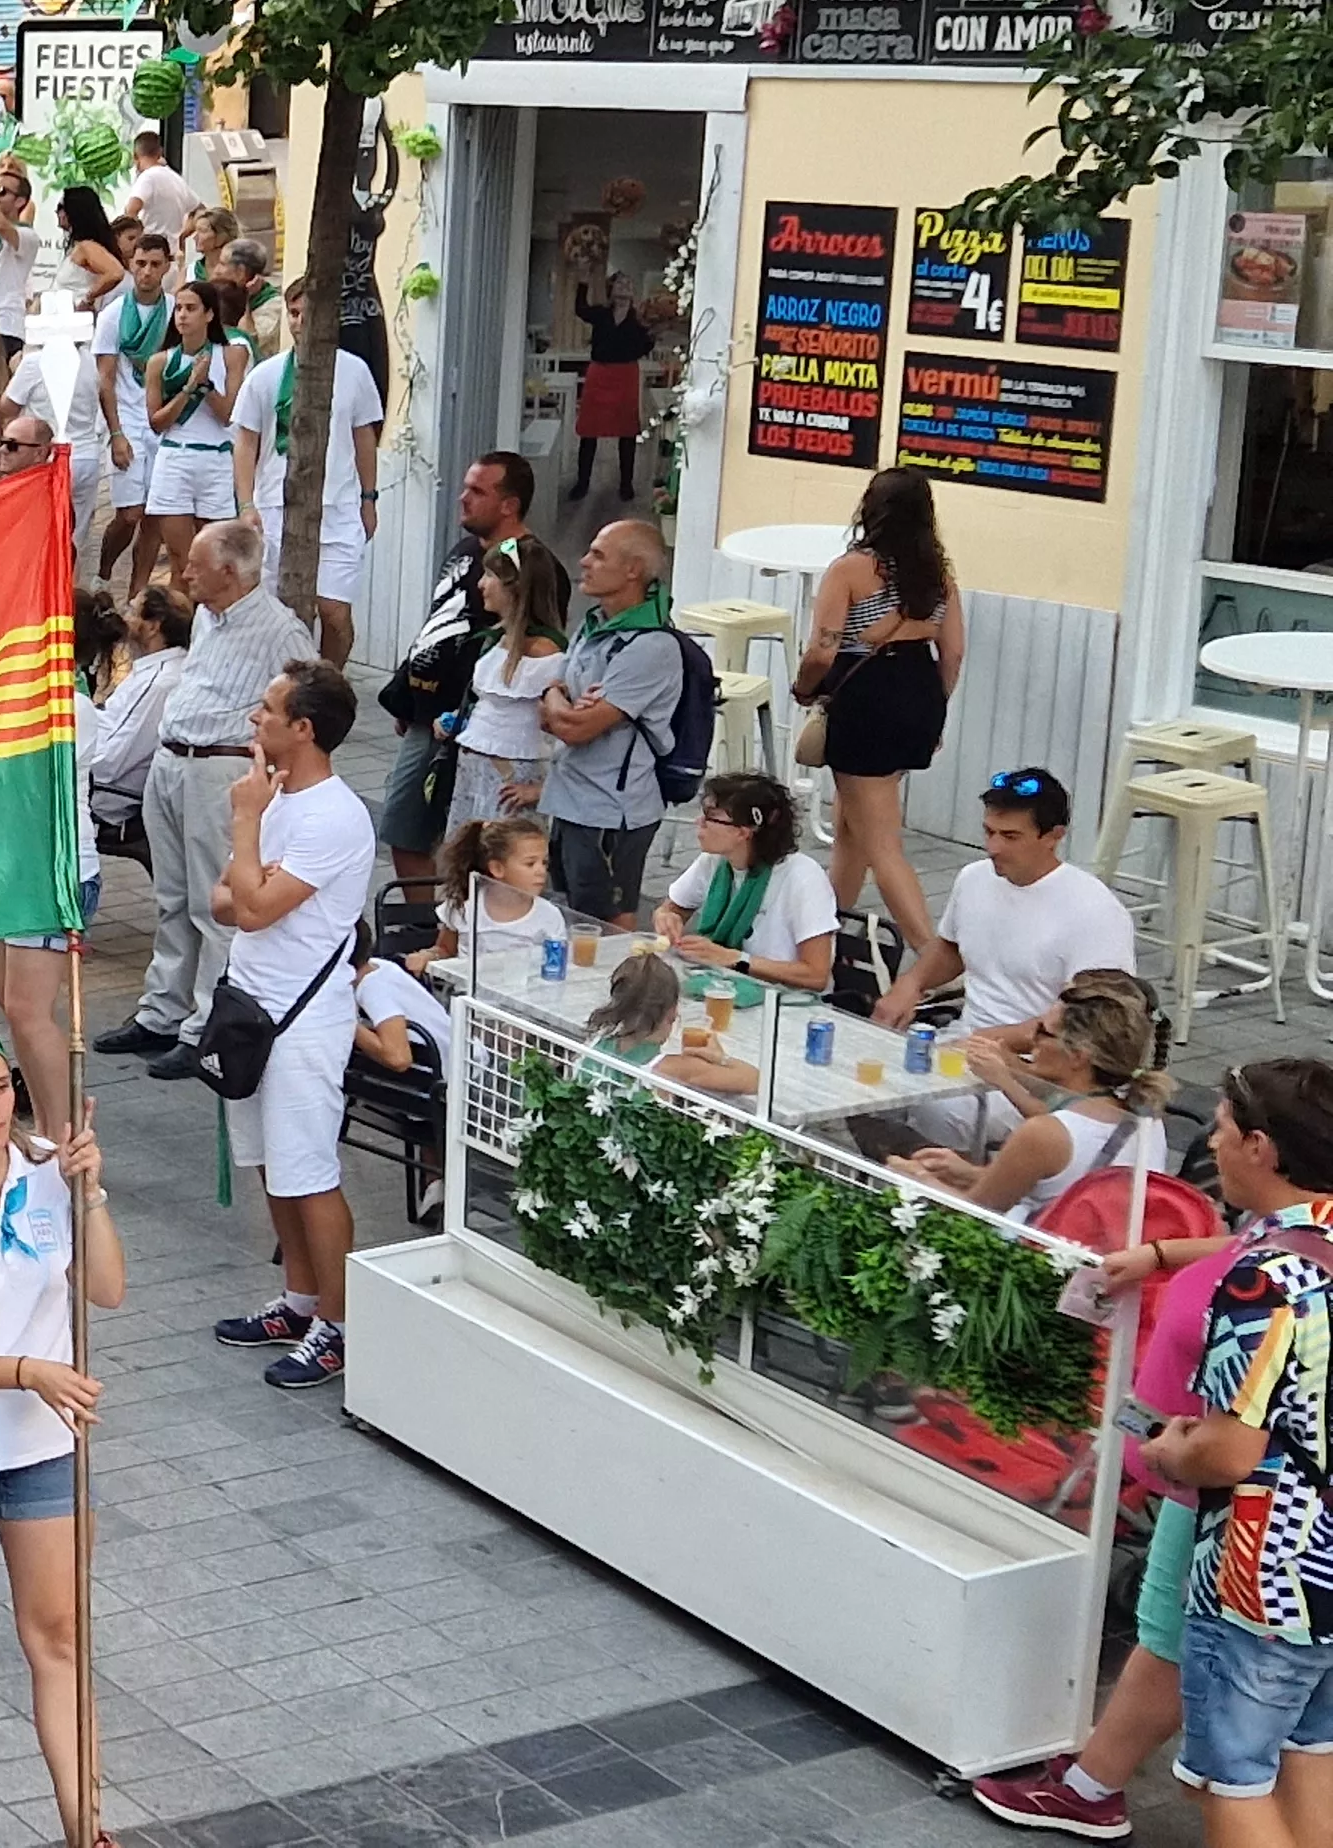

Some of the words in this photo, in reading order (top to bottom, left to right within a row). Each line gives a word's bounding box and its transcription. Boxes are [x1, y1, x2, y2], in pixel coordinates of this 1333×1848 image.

[817, 7, 901, 30] masa
[935, 15, 988, 51] CON
[994, 15, 1073, 52] AMOR
[802, 33, 916, 60] casera
[35, 75, 131, 101] FIESTA
[770, 215, 885, 259] Arroces
[917, 211, 1007, 265] Pizza
[766, 295, 821, 323] ARROZ
[825, 300, 881, 328] NEGRO
[796, 321, 880, 360] SEÑORITO
[823, 360, 878, 388] MIXTA
[907, 364, 1001, 401] vermú
[759, 381, 879, 418] PRUÉBALOS
[757, 425, 791, 447] LOS
[794, 429, 853, 457] DEDOS
